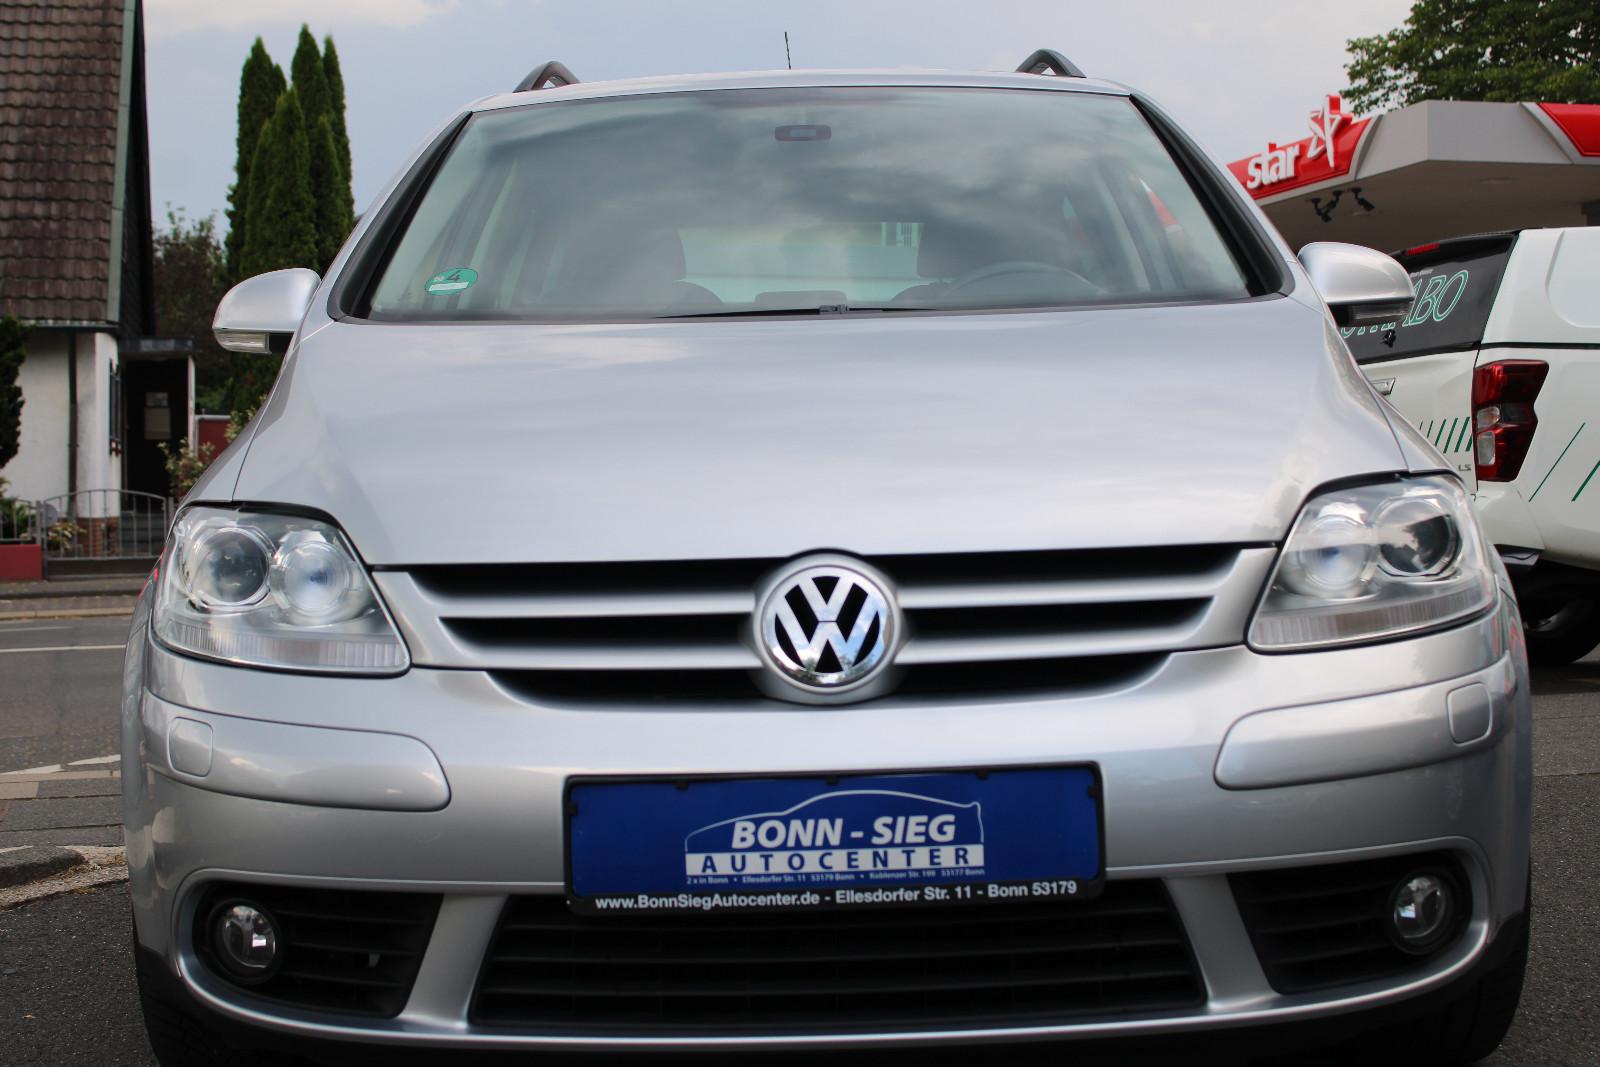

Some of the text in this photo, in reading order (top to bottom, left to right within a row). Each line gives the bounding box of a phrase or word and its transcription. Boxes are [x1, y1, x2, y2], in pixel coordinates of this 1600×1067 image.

[1246, 142, 1300, 189] star
[731, 818, 844, 849] BONN
[871, 814, 956, 845] SIEG
[701, 847, 969, 873] AUTOCENTER
[708, 876, 728, 884] Bonn
[742, 875, 782, 884] Ellesdorfer
[798, 874, 806, 882] 11
[835, 873, 855, 881] Bonn
[965, 868, 985, 876] Bonn
[596, 891, 820, 910] www.BonnSiegAutocenter.de
[836, 888, 920, 904] Ellesdorfer
[924, 886, 950, 900] Str.
[955, 885, 971, 898] 11
[988, 883, 1028, 898] Bonn
[1032, 880, 1077, 895] 53179
